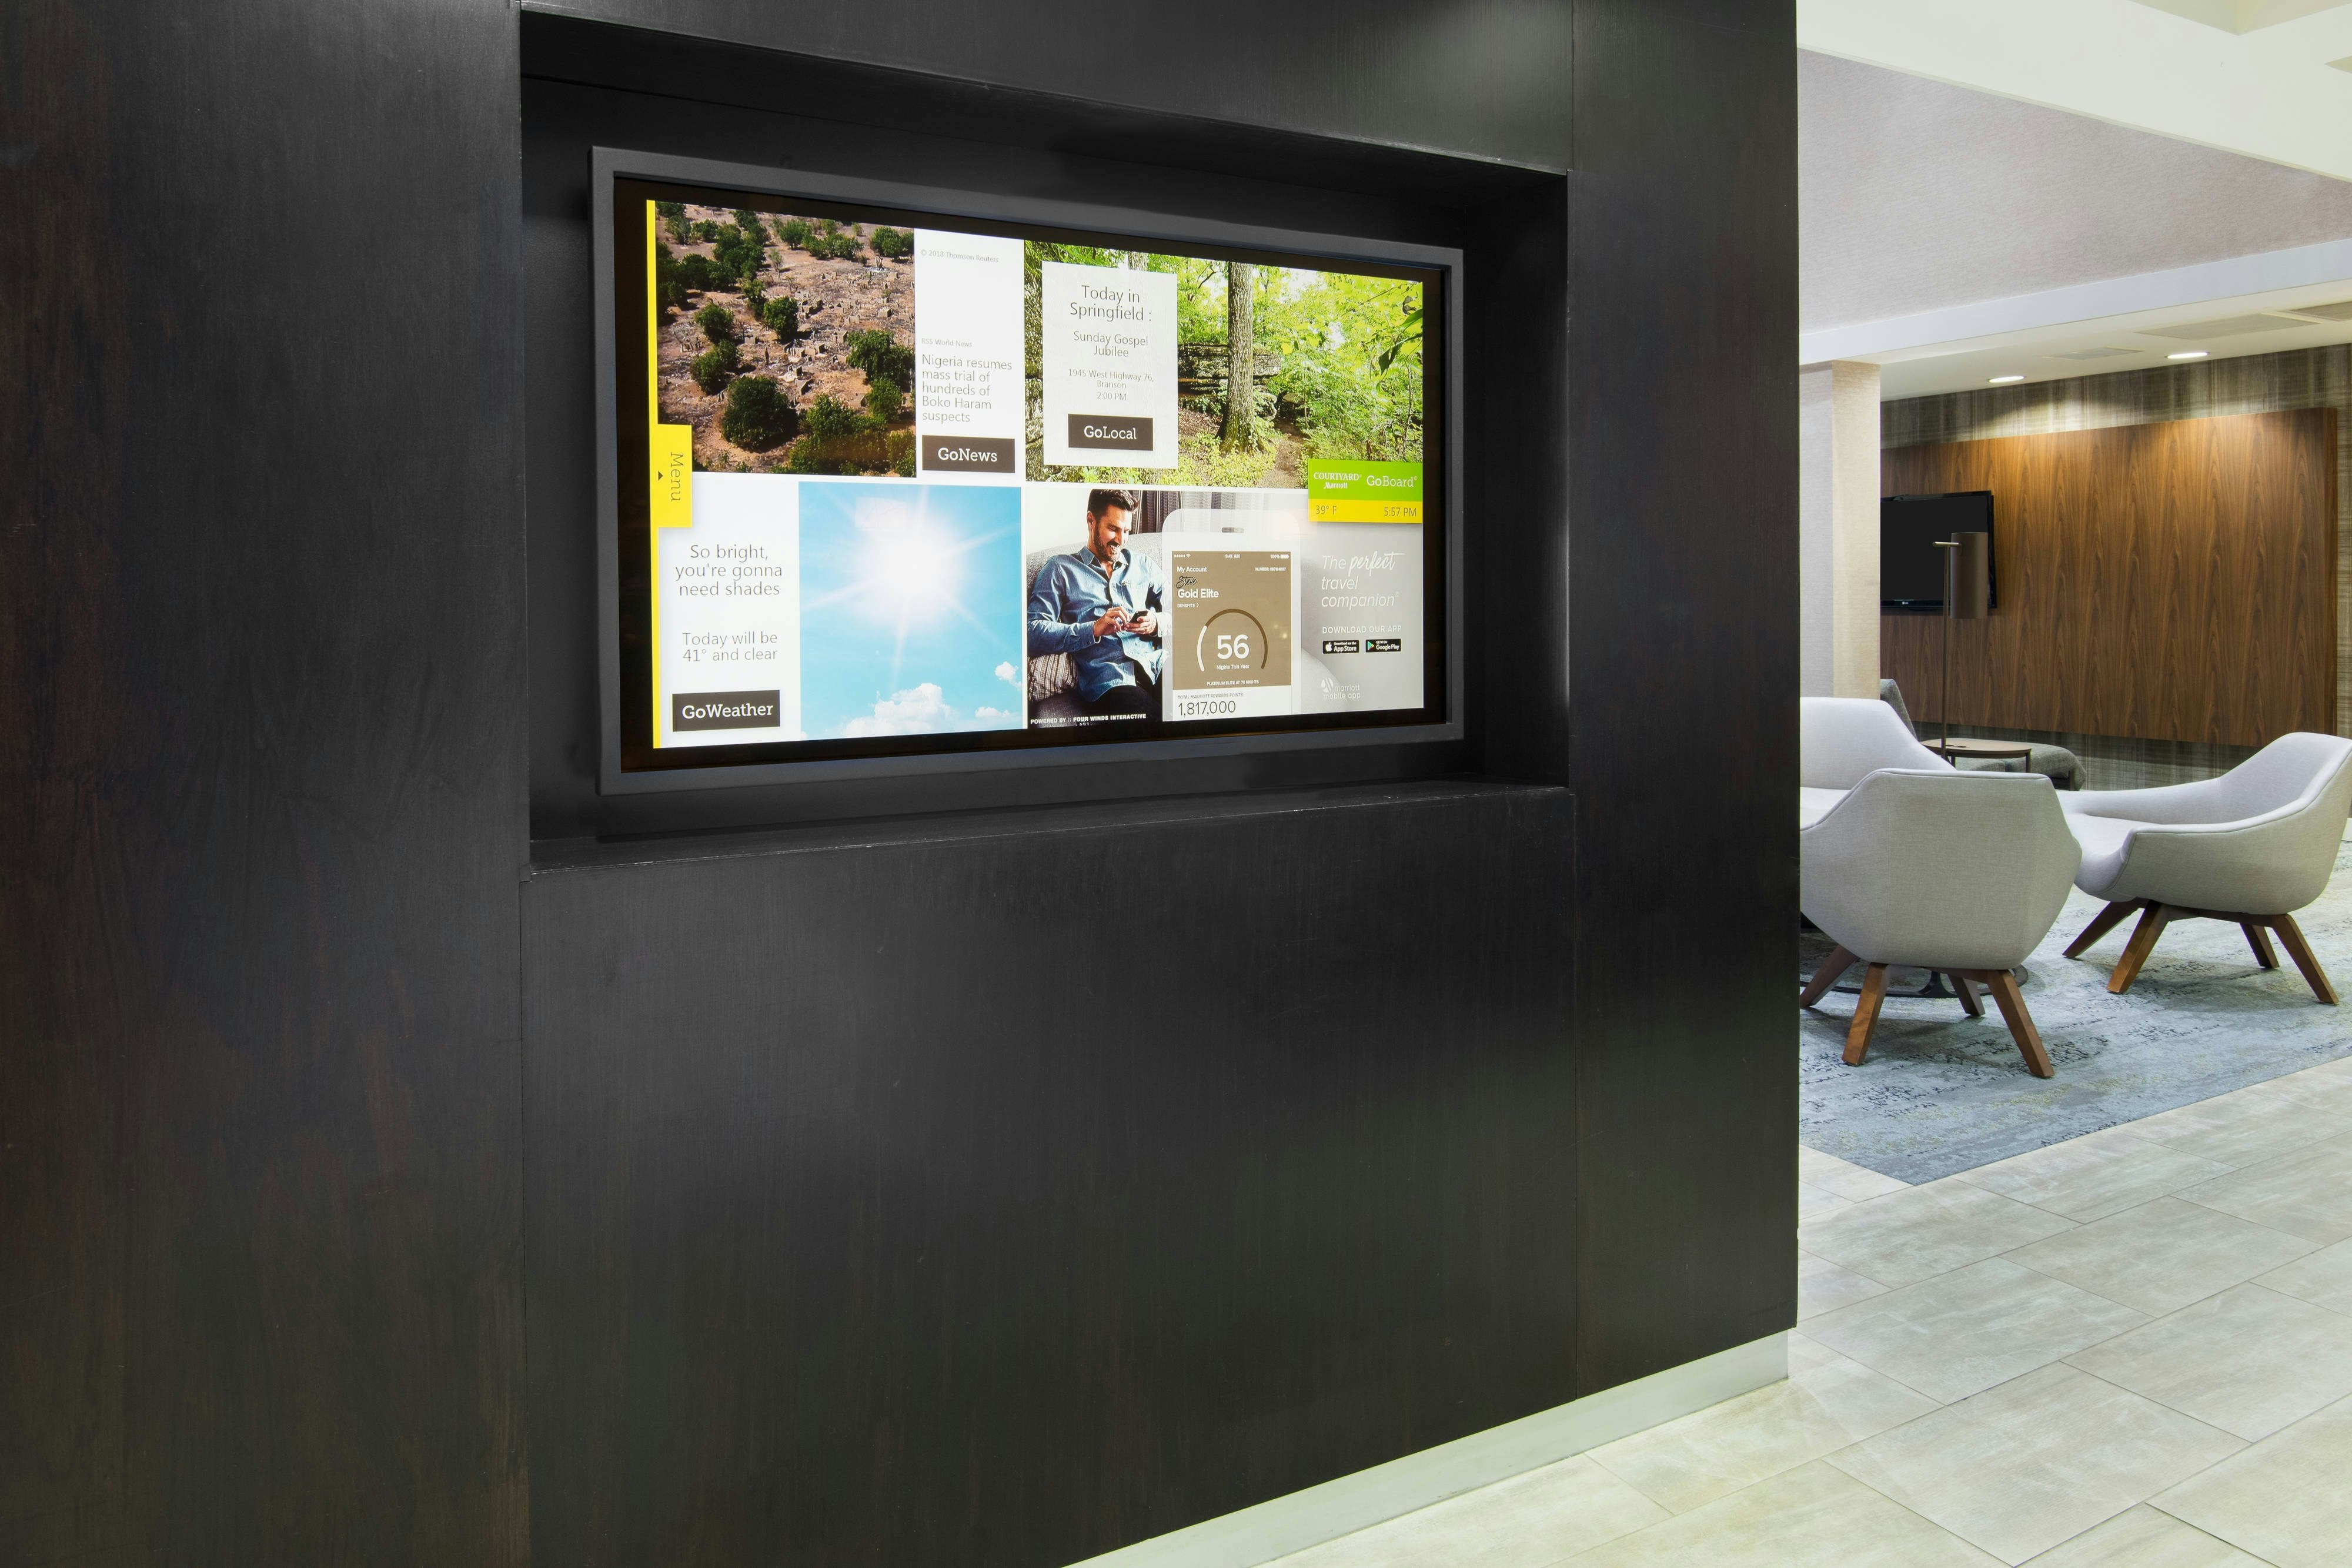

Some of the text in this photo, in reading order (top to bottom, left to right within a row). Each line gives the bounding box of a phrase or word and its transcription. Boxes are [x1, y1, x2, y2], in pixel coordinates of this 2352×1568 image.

[946, 252, 974, 260] Thomson
[976, 255, 999, 263] Reuters
[1082, 285, 1140, 305] Today in
[1070, 302, 1144, 322] Springfield
[1074, 330, 1148, 348] Sunday Gospel
[1094, 345, 1129, 357] Jubilee
[922, 354, 1013, 370] Nigeria resumes
[922, 370, 991, 382] mass trial of
[1068, 369, 1154, 383] 1945 West Highway 76,
[922, 381, 991, 396] hundreds of
[1097, 380, 1127, 389] Branson
[922, 396, 991, 409] Boko Haram
[1097, 392, 1112, 400] 2:00
[922, 412, 971, 424] suspects
[1084, 425, 1137, 440] GoLocal
[938, 447, 998, 462] GoNews
[670, 452, 684, 502] Menu
[1332, 506, 1337, 515] F
[1384, 507, 1417, 517] 5:57 PM
[690, 544, 768, 563] So bright,
[1322, 550, 1406, 577] The perfect
[675, 563, 782, 581] you're gonna
[679, 581, 780, 596] need shades
[1175, 576, 1198, 589] Steve
[1321, 576, 1359, 590] travel
[1177, 589, 1220, 599] Gold Elite
[1322, 626, 1367, 634] DOWNLOAD
[1368, 625, 1385, 633] OUR
[682, 631, 777, 648] Today will be
[1217, 634, 1250, 660] 56
[682, 647, 778, 662] 41° and clear
[1322, 692, 1346, 700] mobile
[681, 703, 774, 719] GoWeather
[1178, 700, 1236, 717] 1,817,000
